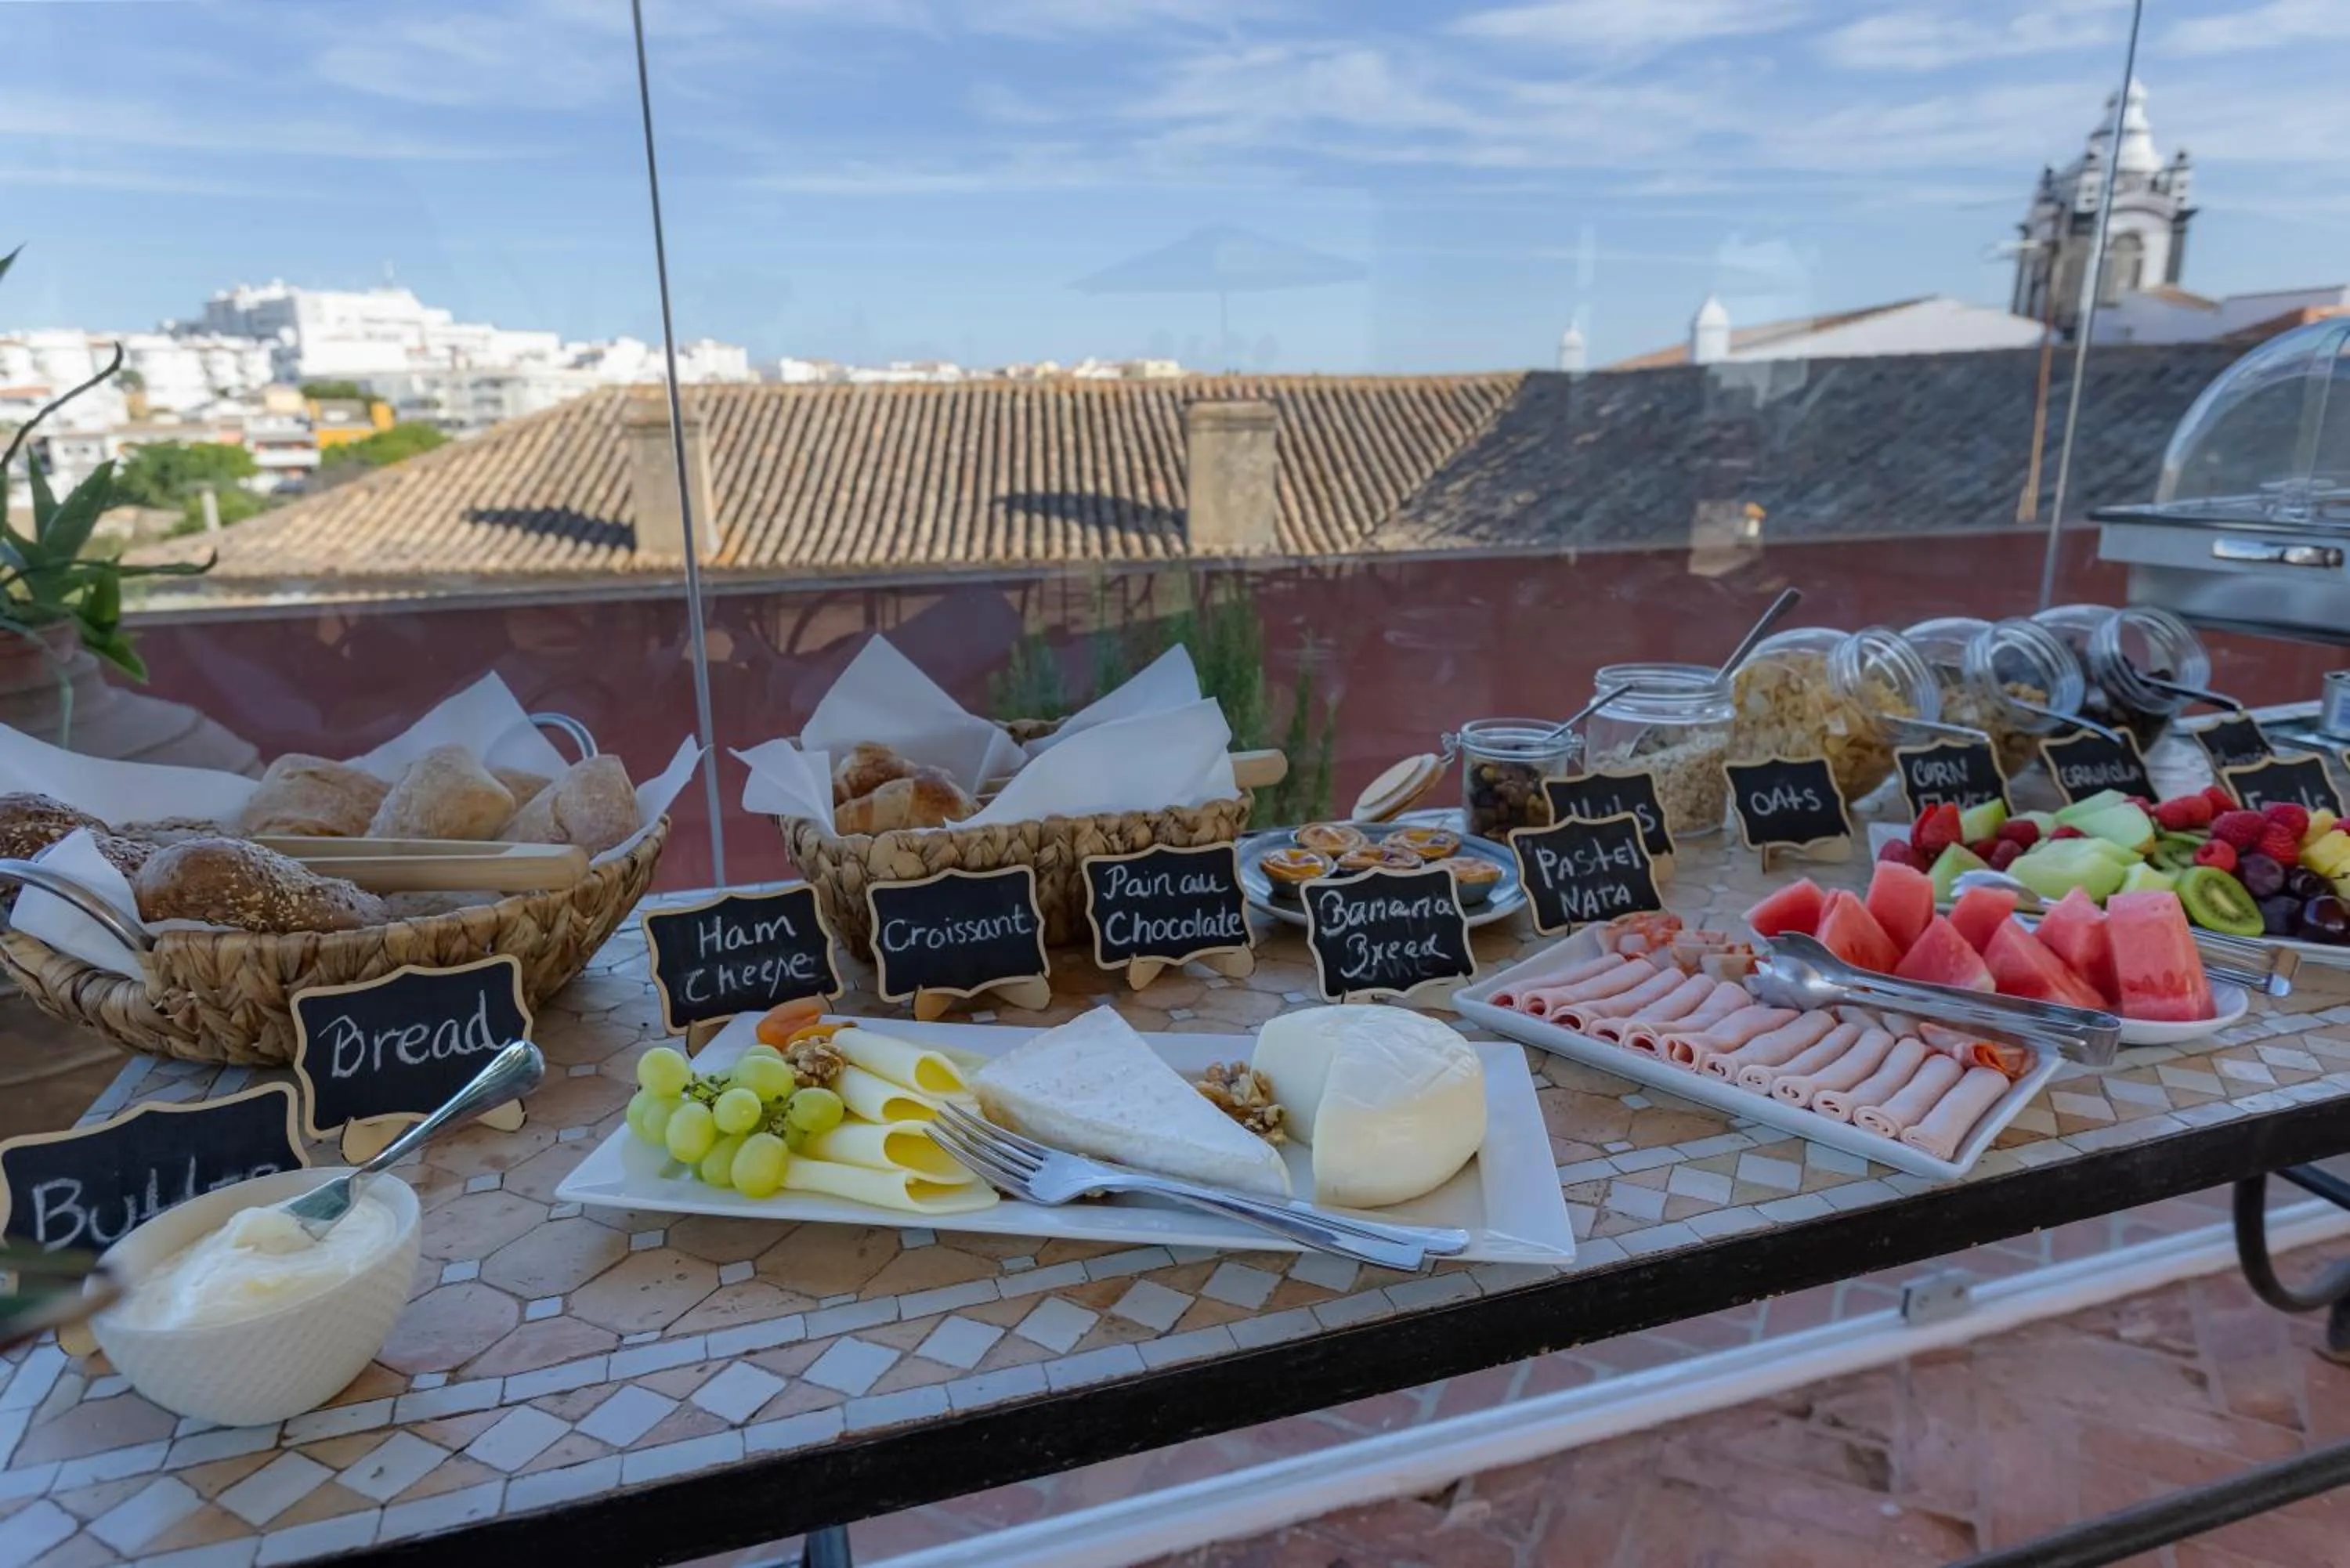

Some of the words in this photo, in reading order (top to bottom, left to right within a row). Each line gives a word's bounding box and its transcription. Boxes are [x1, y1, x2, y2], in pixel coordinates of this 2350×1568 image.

[1911, 757, 1969, 787] CORN
[1103, 865, 1175, 900] Pain
[1179, 871, 1228, 895] au
[1559, 883, 1632, 919] NATA
[883, 903, 1032, 952] Croissant
[1105, 903, 1244, 946] Chocolate
[1319, 889, 1455, 938] Banana
[699, 915, 796, 959] Ham
[1340, 932, 1452, 978] Bread
[316, 989, 512, 1079] Bread
[32, 1154, 280, 1252] Butt
